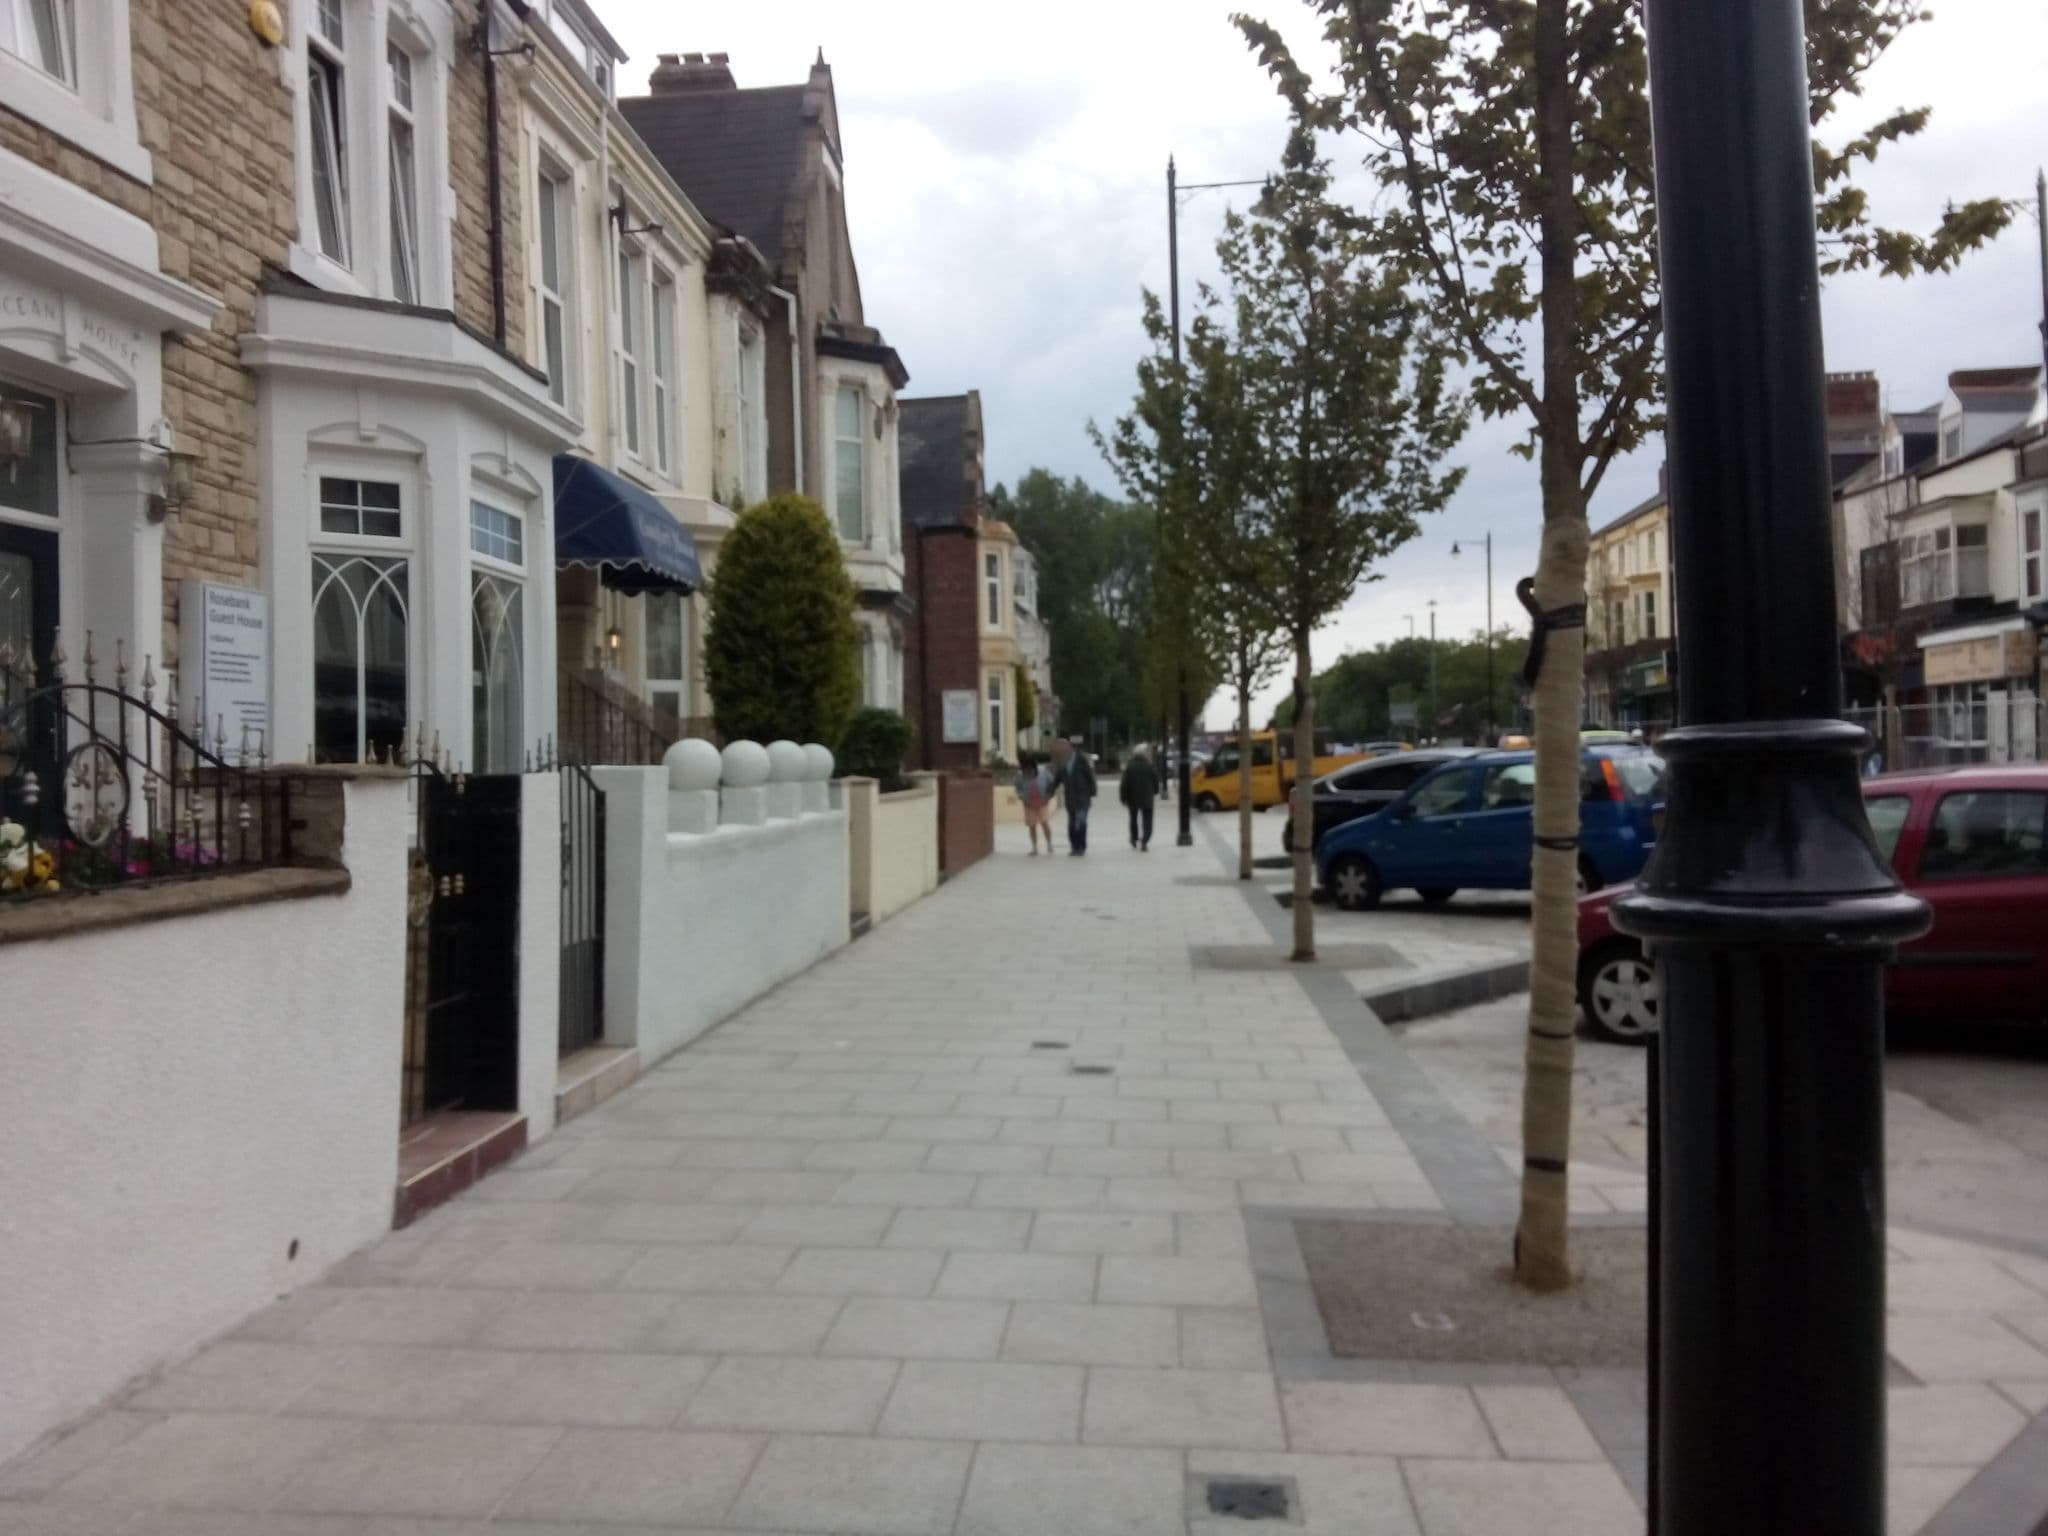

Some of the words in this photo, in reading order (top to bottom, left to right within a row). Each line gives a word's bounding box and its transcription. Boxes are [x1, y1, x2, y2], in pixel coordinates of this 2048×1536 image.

[0, 295, 56, 321] CEAN
[83, 319, 139, 368] HOUSE
[209, 590, 250, 609] Rosebank
[209, 609, 234, 625] Guest
[237, 613, 263, 630] House
